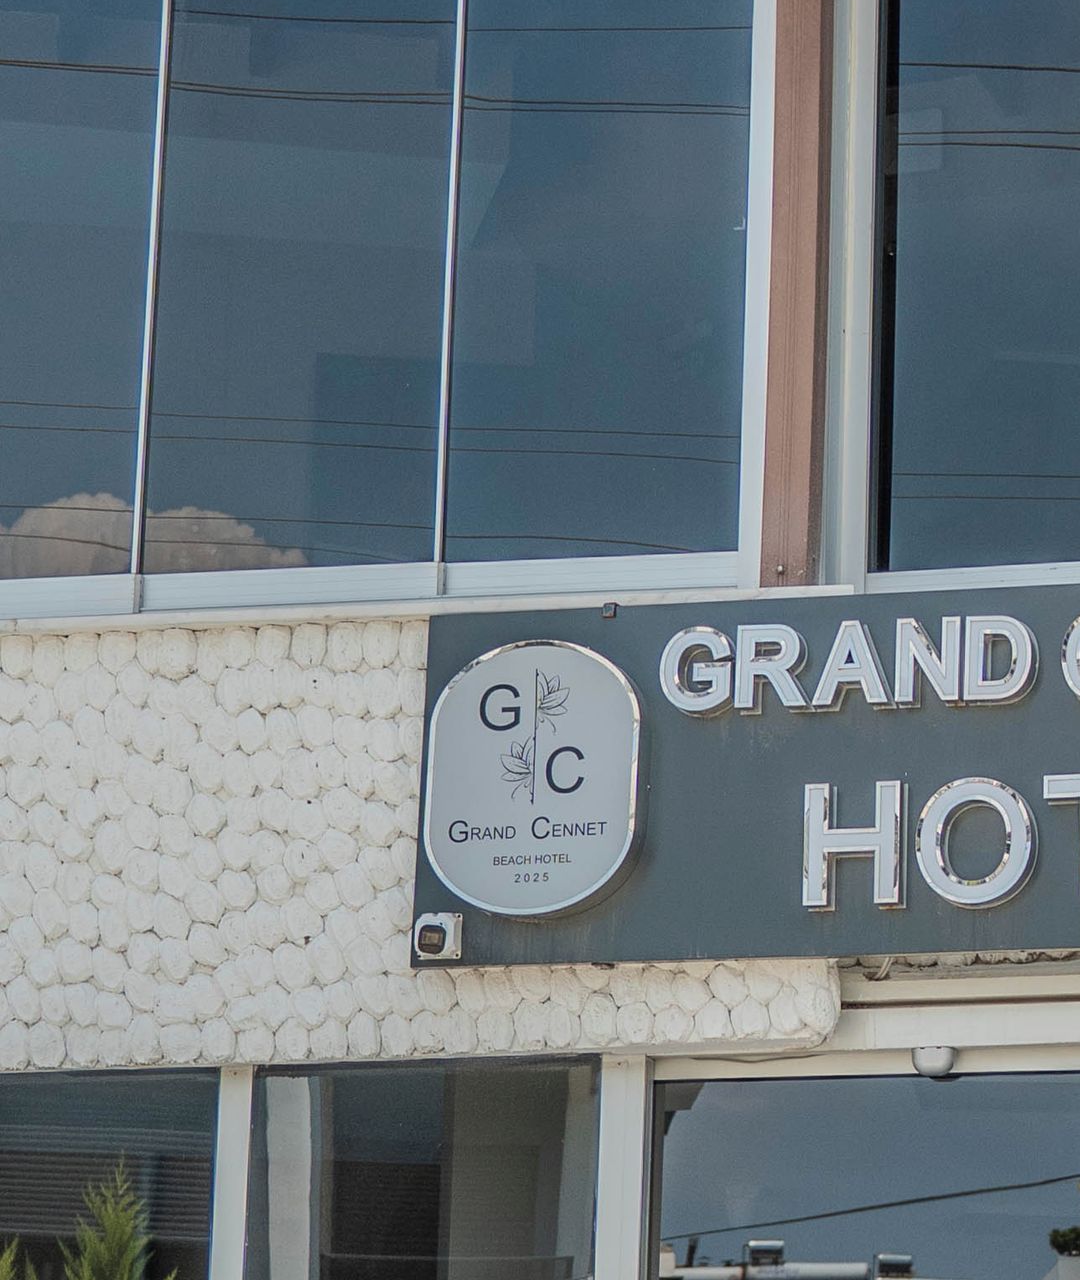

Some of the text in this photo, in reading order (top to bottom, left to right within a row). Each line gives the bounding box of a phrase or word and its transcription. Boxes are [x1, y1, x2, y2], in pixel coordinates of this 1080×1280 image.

[659, 615, 1038, 716] GRAND
[479, 684, 521, 732] G
[545, 746, 585, 794] C
[448, 816, 608, 843] GRAND CENNET
[493, 853, 572, 866] BEACH HOTEL
[514, 872, 549, 884] 2025
